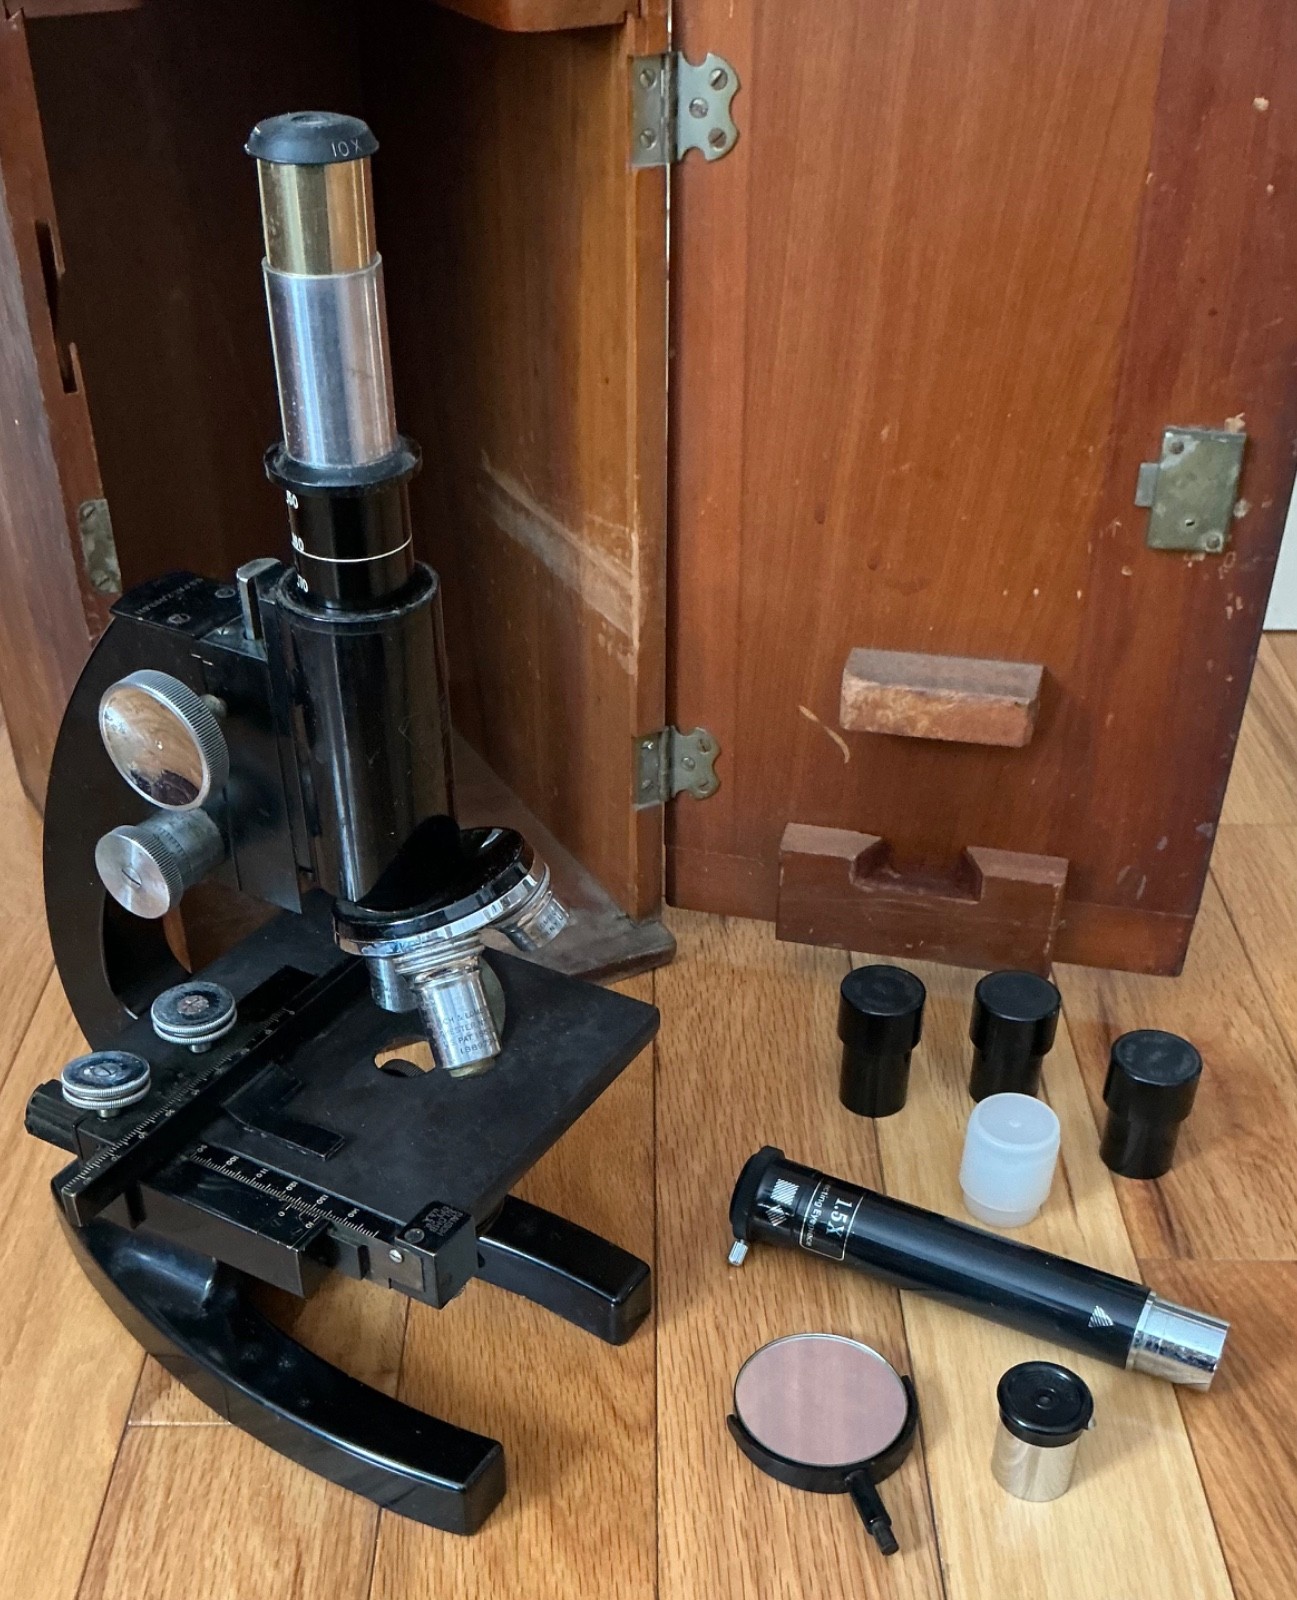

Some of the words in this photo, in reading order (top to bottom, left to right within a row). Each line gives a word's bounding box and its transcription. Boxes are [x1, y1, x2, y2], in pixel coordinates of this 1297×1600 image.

[331, 139, 361, 157] 10X
[256, 1168, 269, 1178] 110
[826, 1198, 852, 1238] 1.5X
